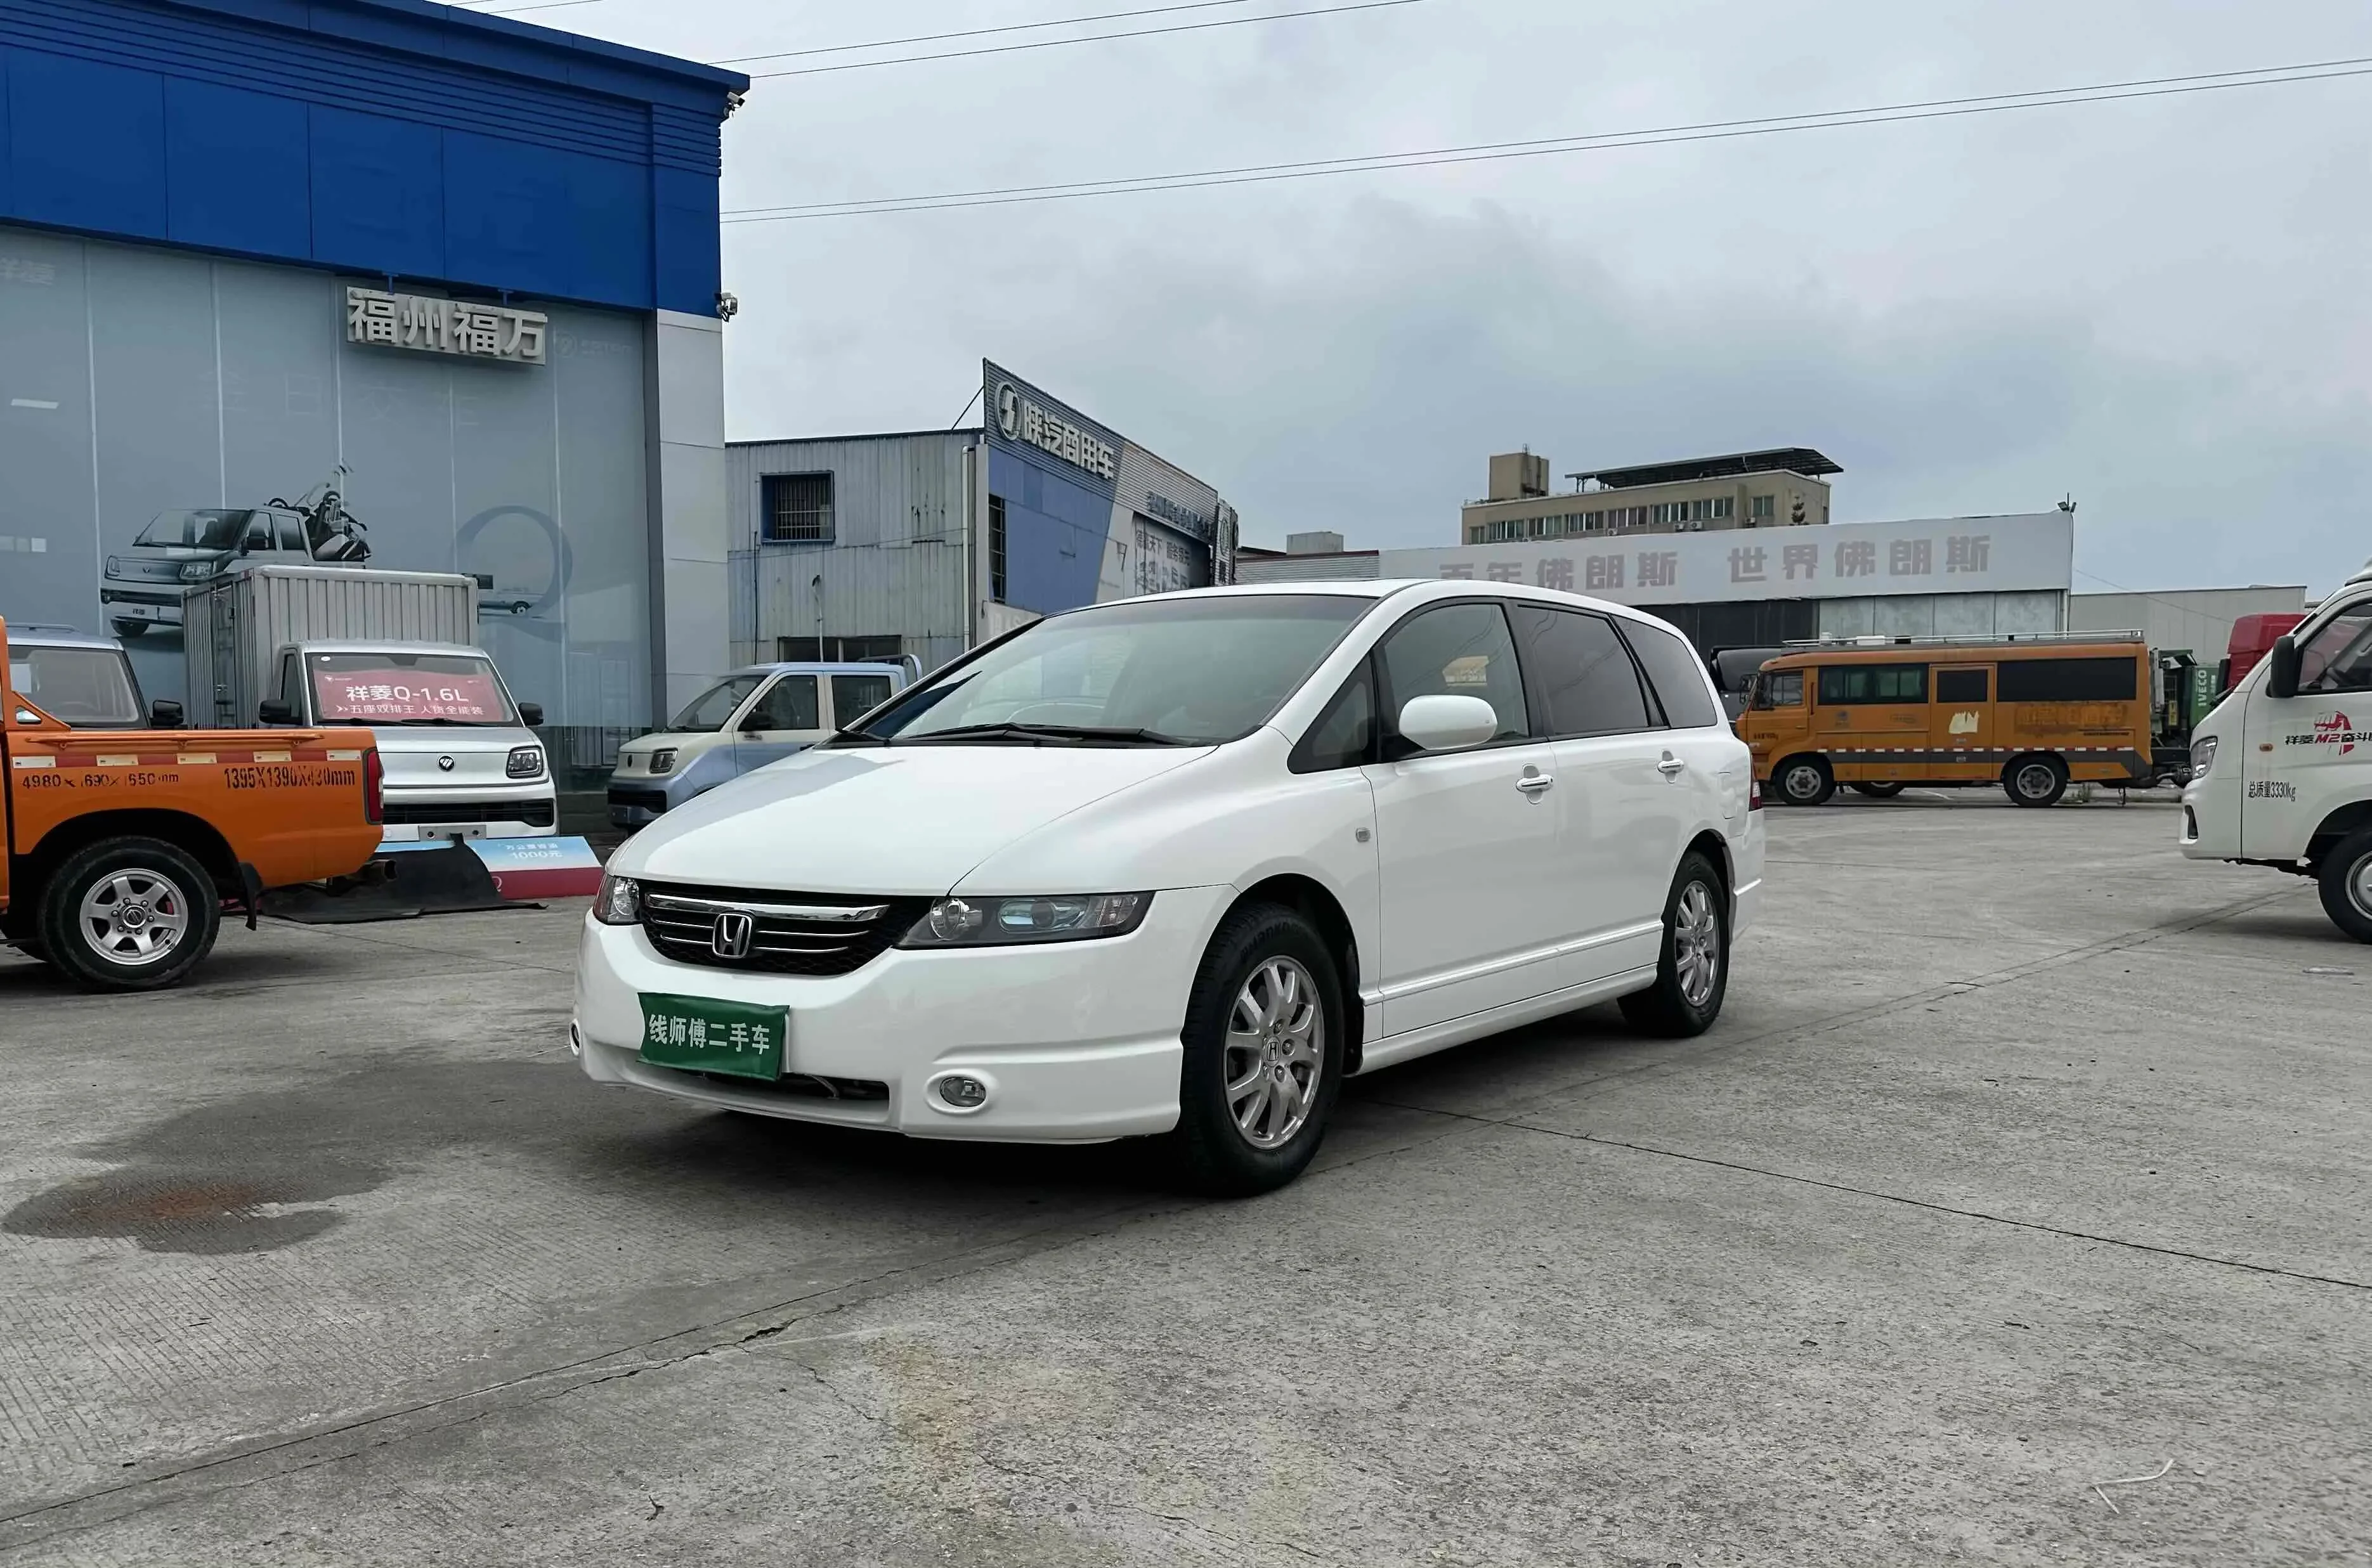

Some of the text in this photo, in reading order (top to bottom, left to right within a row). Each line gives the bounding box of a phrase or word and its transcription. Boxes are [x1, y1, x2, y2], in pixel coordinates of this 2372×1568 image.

[349, 289, 548, 356] 福州福万
[1727, 535, 1990, 583] 世界佛朗斯
[346, 685, 469, 702] 祥菱Q-1.6L
[2198, 670, 2207, 706] IVECO
[2285, 732, 2372, 745] 祥菱M2奋斗
[2248, 781, 2296, 801] 总质量3330kg
[649, 1014, 770, 1055] 线师傅二手车
